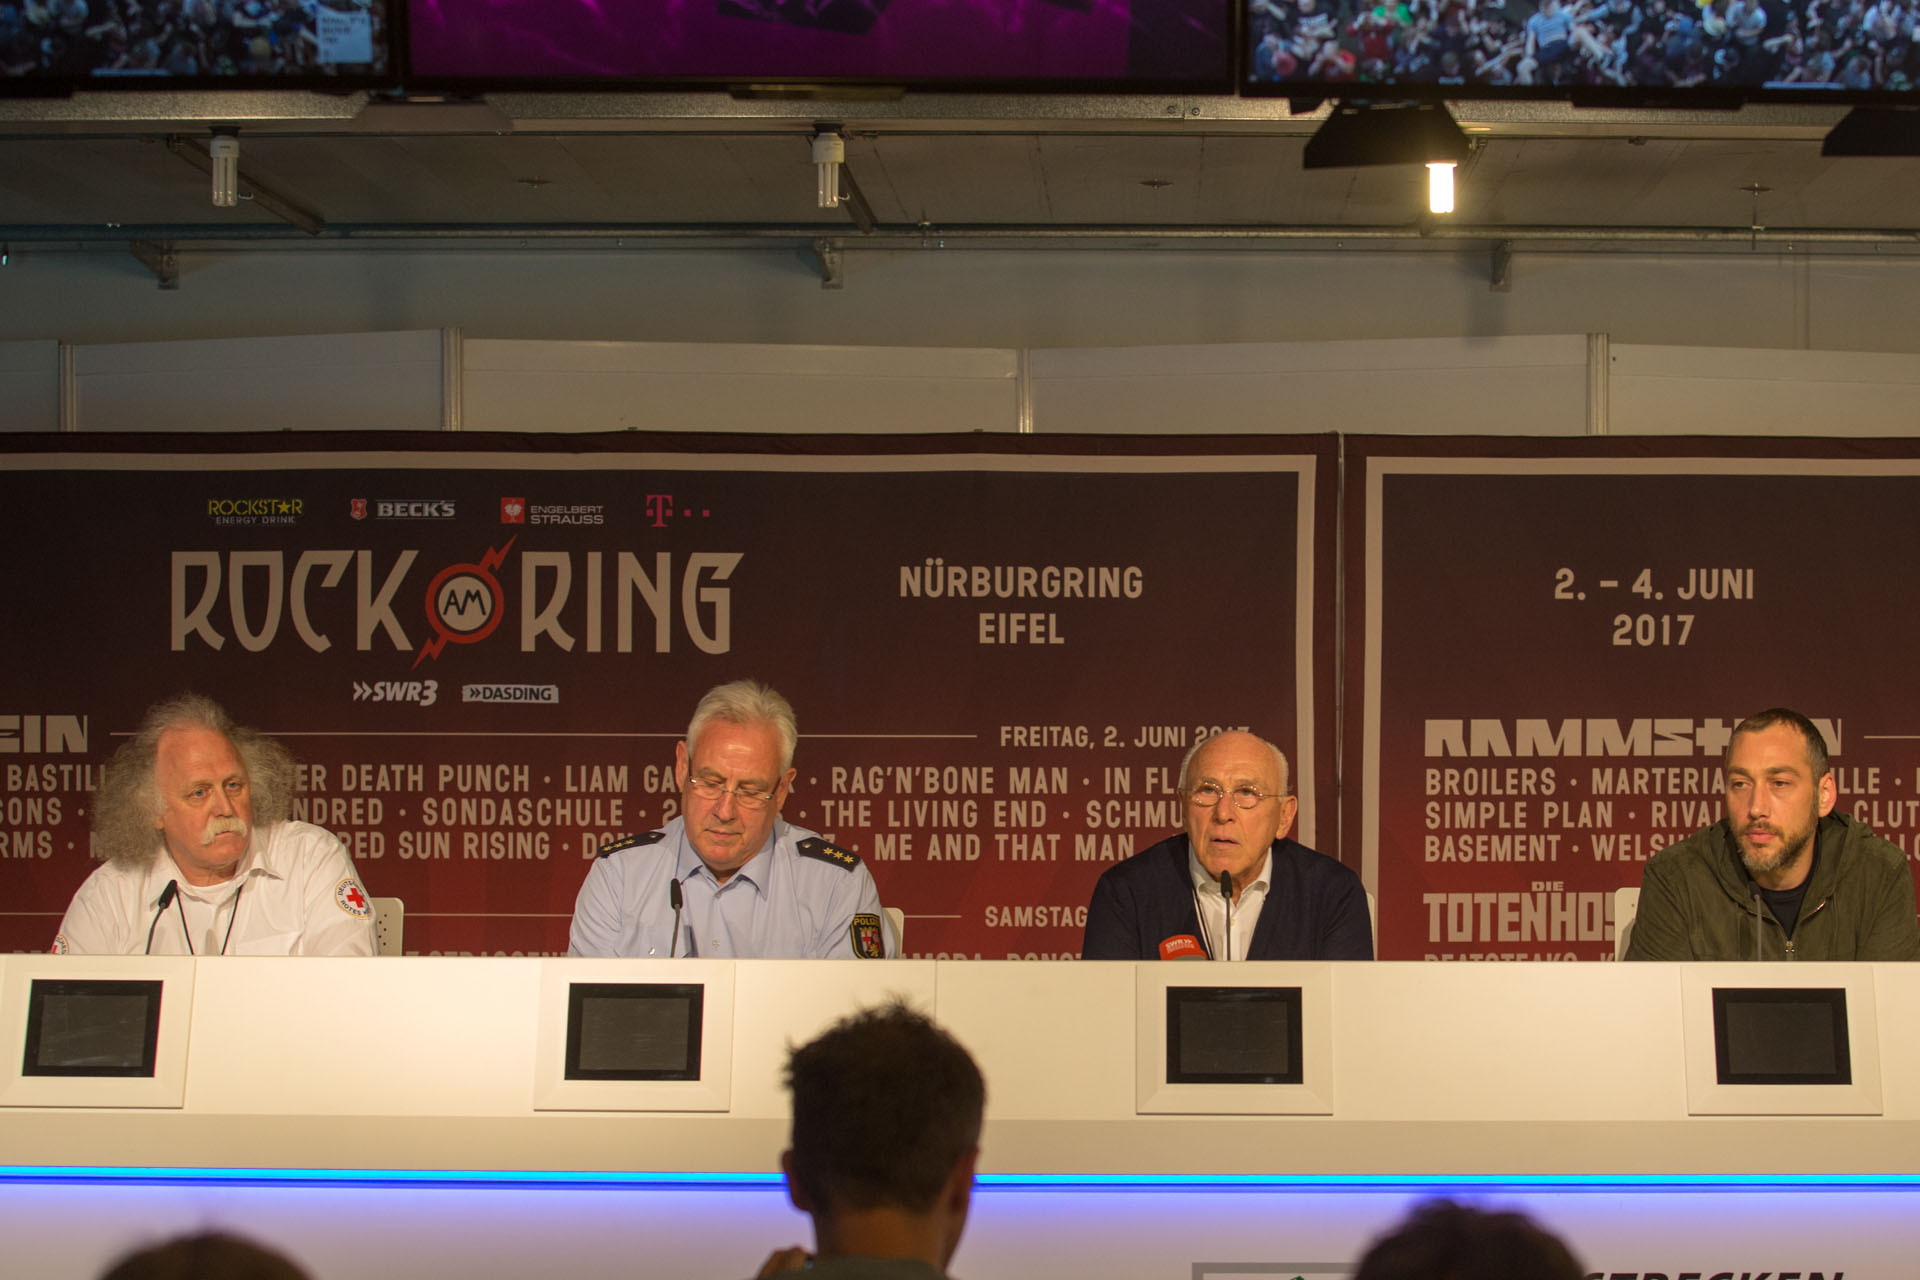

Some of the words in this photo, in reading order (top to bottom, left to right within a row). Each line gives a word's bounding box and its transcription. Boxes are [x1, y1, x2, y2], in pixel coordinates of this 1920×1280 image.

[215, 516, 257, 526] ENERGY
[261, 516, 296, 525] DRINK
[376, 500, 456, 517] BECK'S
[530, 505, 603, 514] ENGELBERT
[530, 515, 604, 525] STRAUSS
[901, 558, 1142, 598] NÜRBURGRING
[1555, 568, 1585, 600] 2.
[1632, 569, 1663, 600] 4.
[1678, 569, 1753, 599] JUNI
[171, 550, 420, 653] ROCK
[443, 590, 487, 617] AM
[521, 552, 744, 654] RING
[980, 613, 1064, 644] EIFEL
[1613, 614, 1694, 646] 2017
[371, 680, 438, 706] SWR3
[482, 686, 551, 701] DASDING
[1001, 726, 1094, 749] FREITAG,
[1104, 726, 1124, 747] 2.
[1134, 727, 1185, 747] JUNI
[343, 765, 423, 791] DEATH
[439, 764, 528, 792] PUNCH
[566, 765, 627, 792] LIAM
[643, 764, 678, 794] GA
[832, 766, 993, 794] RAG'N'BONE
[1010, 767, 1067, 794] MAN
[1105, 768, 1130, 794] IN
[1426, 768, 1555, 795] BROILERS
[1591, 767, 1726, 796] MARTERIA
[292, 797, 383, 826] NDRED
[423, 798, 622, 826] SONDASCHULE
[821, 800, 871, 827] THE
[888, 800, 977, 828] LIVING
[994, 801, 1046, 827] END
[1086, 800, 1183, 829] SCHMU
[1426, 801, 1526, 829] SIMPLE
[1544, 801, 1612, 828] PLAN
[399, 831, 449, 859] SUN
[464, 832, 549, 859] RISING
[875, 834, 912, 860] ME
[927, 834, 980, 860] AND
[995, 834, 1060, 860] THAT
[1074, 833, 1136, 862] MAN
[1425, 835, 1560, 862] BASEMENT
[1531, 881, 1564, 892] DIE
